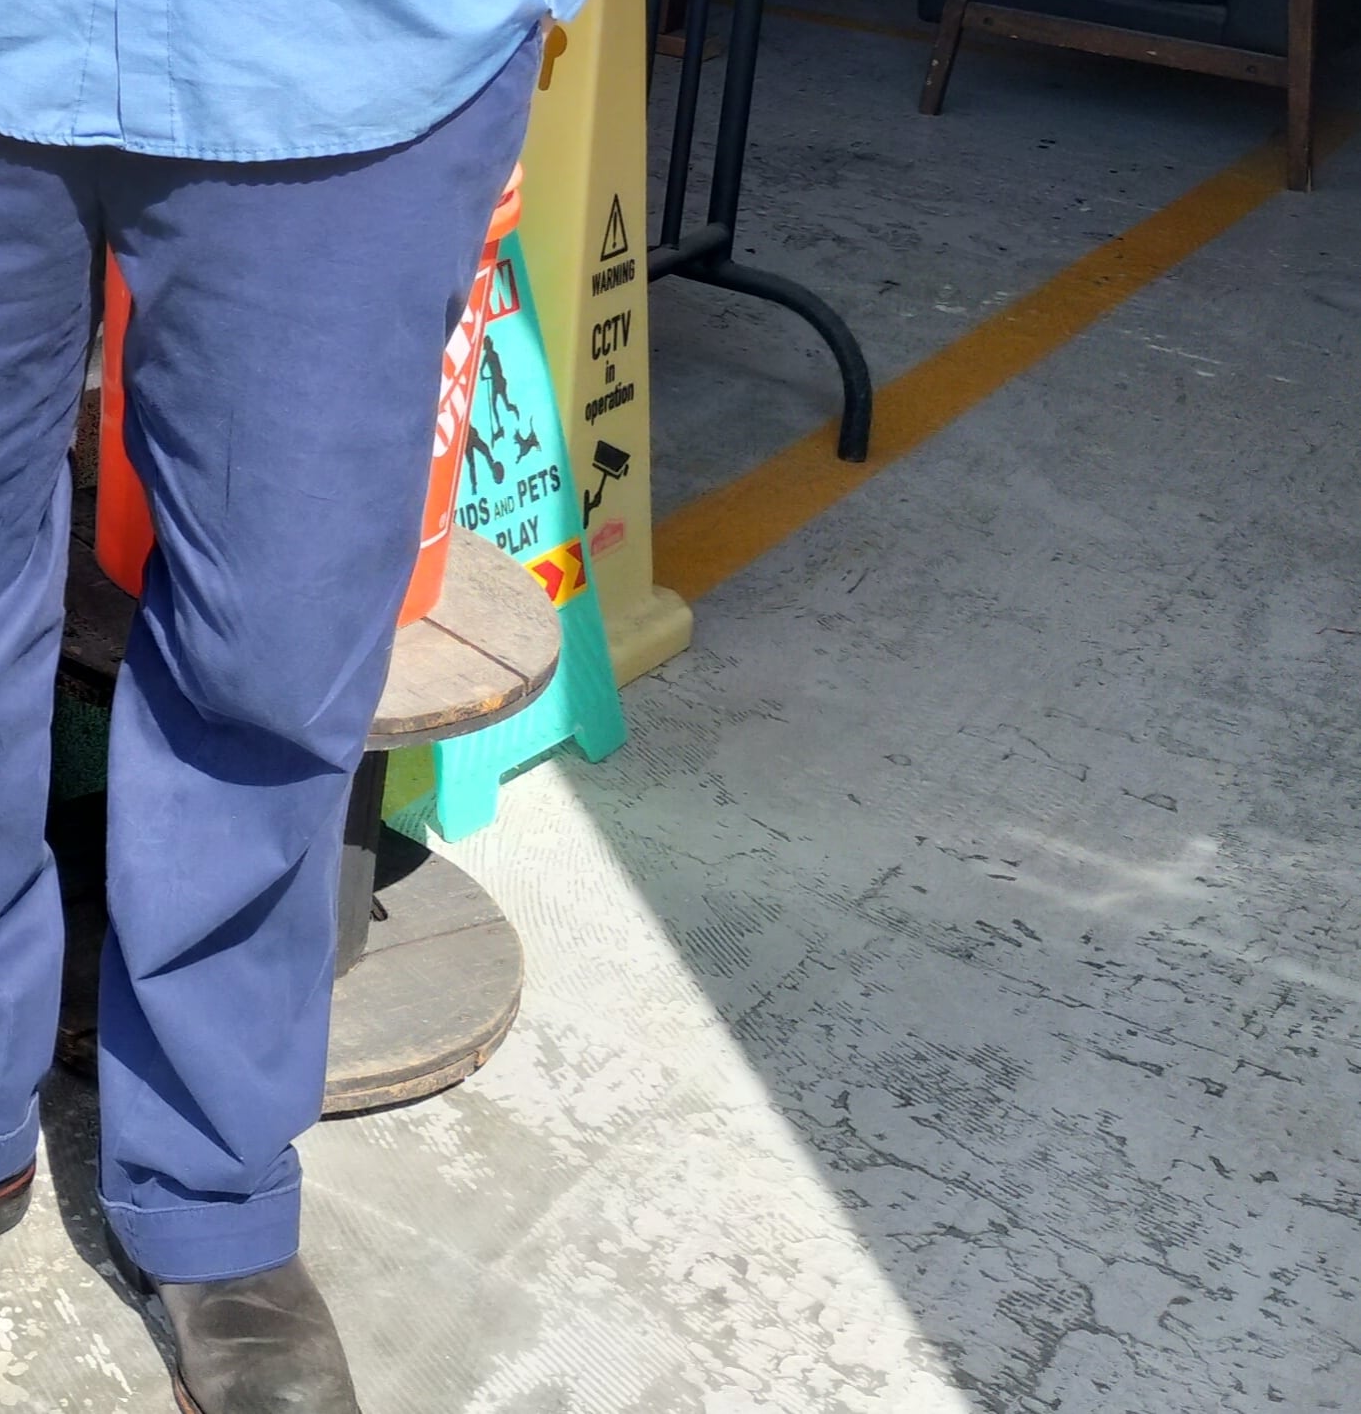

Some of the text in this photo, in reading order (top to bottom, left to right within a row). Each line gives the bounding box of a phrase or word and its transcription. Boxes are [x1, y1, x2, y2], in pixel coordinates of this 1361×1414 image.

[591, 258, 636, 298] WARNING
[592, 309, 632, 361] CCTV
[605, 359, 616, 385] in
[585, 381, 635, 427] operation
[453, 464, 561, 531] IDS AND PETS
[495, 515, 538, 555] PLAY
